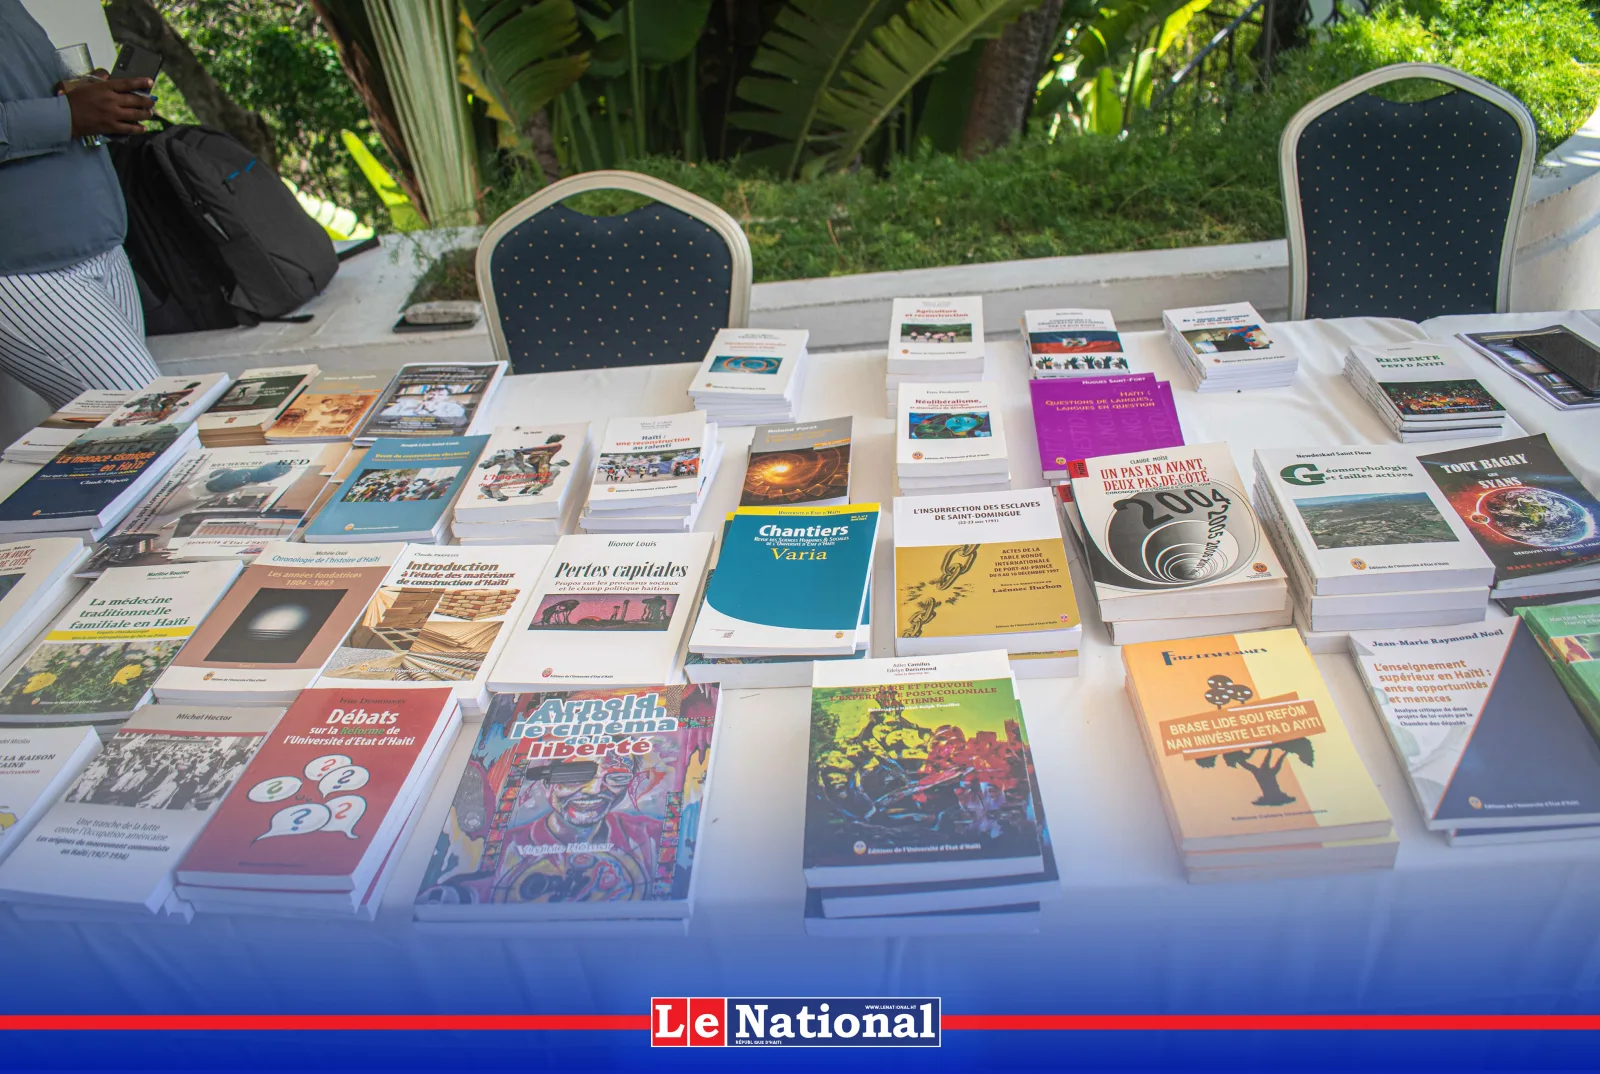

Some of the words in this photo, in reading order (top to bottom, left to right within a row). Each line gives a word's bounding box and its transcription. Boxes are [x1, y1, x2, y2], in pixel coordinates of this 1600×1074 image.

[1375, 354, 1441, 363] RESPEKTE
[1112, 402, 1155, 410] QUESTION
[633, 437, 690, 446] reconstruction
[56, 455, 72, 463] La
[70, 455, 111, 463] menace
[110, 451, 156, 463] sismique
[116, 460, 148, 471] Haïti
[1100, 468, 1118, 480] UN
[1120, 466, 1143, 478] PAS
[1145, 463, 1162, 475] EN
[1166, 458, 1206, 473] AVANT,
[1440, 461, 1477, 474] TOUT
[1478, 453, 1528, 469] BAGAY
[1103, 479, 1136, 491] DEUX
[1138, 477, 1159, 488] PAS
[1161, 475, 1177, 486] DE
[1478, 476, 1522, 489] SYANS
[914, 505, 981, 514] L'INSURRECTION
[1001, 501, 1040, 510] ESCLAVES
[1113, 488, 1231, 529] 2004
[1207, 504, 1228, 539] 2005
[948, 510, 1021, 520] SAINT-DOMINGUE
[760, 525, 848, 536] Chantiers
[272, 555, 314, 564] Chronologie
[771, 548, 827, 560] Varia
[406, 561, 499, 571] Introduction
[995, 558, 1050, 566] INTERNATIONALE
[1003, 564, 1053, 572] PORT-AU-PRINCE
[283, 571, 313, 579] années
[555, 562, 610, 578] Pertes
[612, 561, 689, 580] capitales
[89, 598, 106, 606] La
[108, 596, 172, 605] médecine
[80, 607, 172, 618] traditionnelle
[68, 620, 130, 629] familiale
[153, 617, 190, 626] Haïti
[1431, 633, 1478, 644] Raymond
[1480, 629, 1504, 637] Noël
[1374, 660, 1467, 672] L'enseignement
[1379, 673, 1435, 683] supérieur
[1438, 672, 1453, 680] en
[1455, 668, 1485, 679] Haïti
[852, 685, 904, 694] HISTOIRE
[906, 688, 997, 697] POST-COLONIALE
[1384, 684, 1414, 692] entre
[1416, 680, 1488, 693] opportunités
[539, 693, 658, 715] Arnold
[1403, 695, 1452, 703] menaces
[177, 713, 204, 721] Michel
[326, 708, 399, 725] Débats
[1169, 721, 1210, 735] BRASE
[1211, 716, 1239, 730] LIDE
[1239, 713, 1264, 725] SOU
[1266, 704, 1307, 721] REFÒM
[340, 726, 384, 735] Réforme
[509, 722, 546, 738] le
[1166, 737, 1192, 750] NAN
[1194, 729, 1250, 746] INIVÈSITE
[1250, 725, 1280, 738] LETA
[1281, 722, 1290, 732] D
[1293, 716, 1322, 731] AYITI
[283, 736, 344, 745] l'Université
[344, 737, 376, 746] d'Etat
[527, 736, 654, 759] liberté
[77, 818, 92, 826] Une
[92, 819, 121, 828] tranche
[122, 821, 132, 829] de
[141, 823, 160, 831] lutte
[54, 826, 78, 834] contre
[78, 828, 125, 839] l'Occupation
[126, 833, 168, 841] américaine
[48, 837, 74, 845] origines
[86, 840, 128, 849] mouvement
[127, 844, 170, 852] communiste
[87, 850, 130, 860] (1927-1936)
